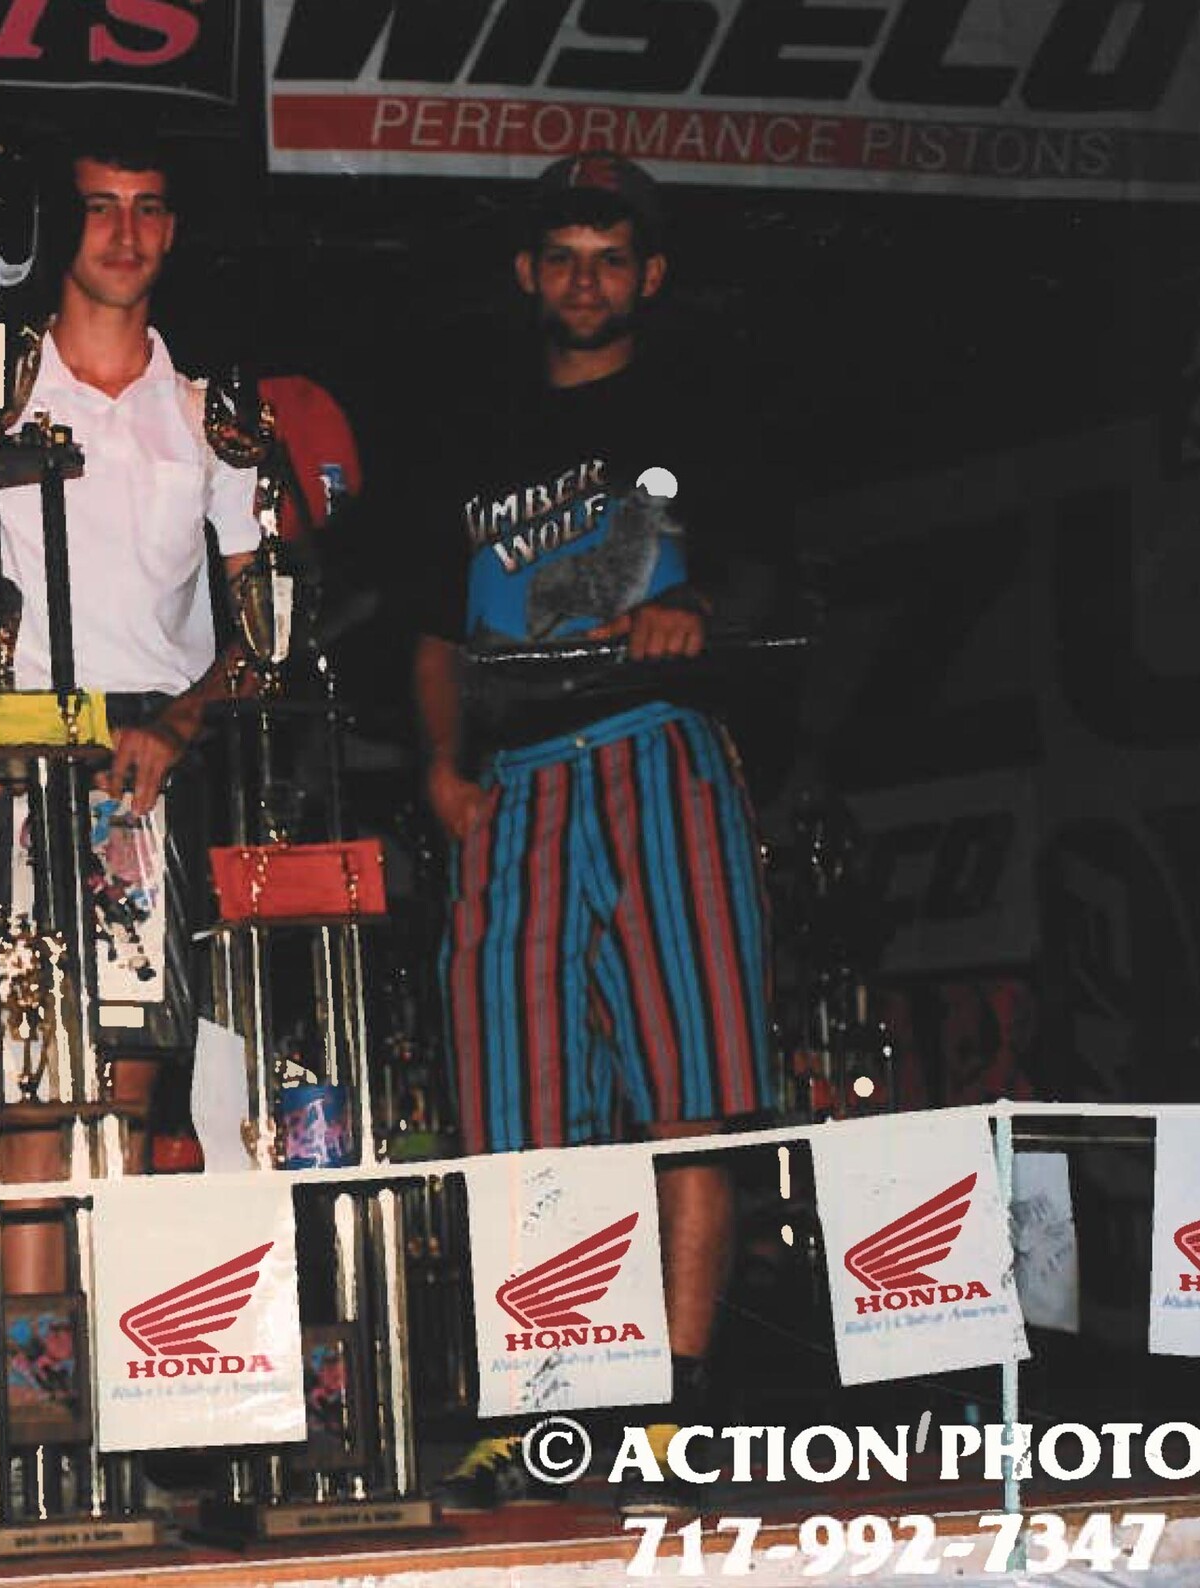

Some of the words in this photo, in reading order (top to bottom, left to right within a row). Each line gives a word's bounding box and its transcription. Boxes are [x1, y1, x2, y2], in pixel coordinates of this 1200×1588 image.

[371, 98, 841, 165] PERFORMANCE
[862, 121, 1115, 177] PISTONS
[493, 492, 606, 572] WOLF
[855, 1281, 992, 1314] HONDA
[505, 1323, 646, 1351] HONDA
[127, 1355, 275, 1379] HONDA
